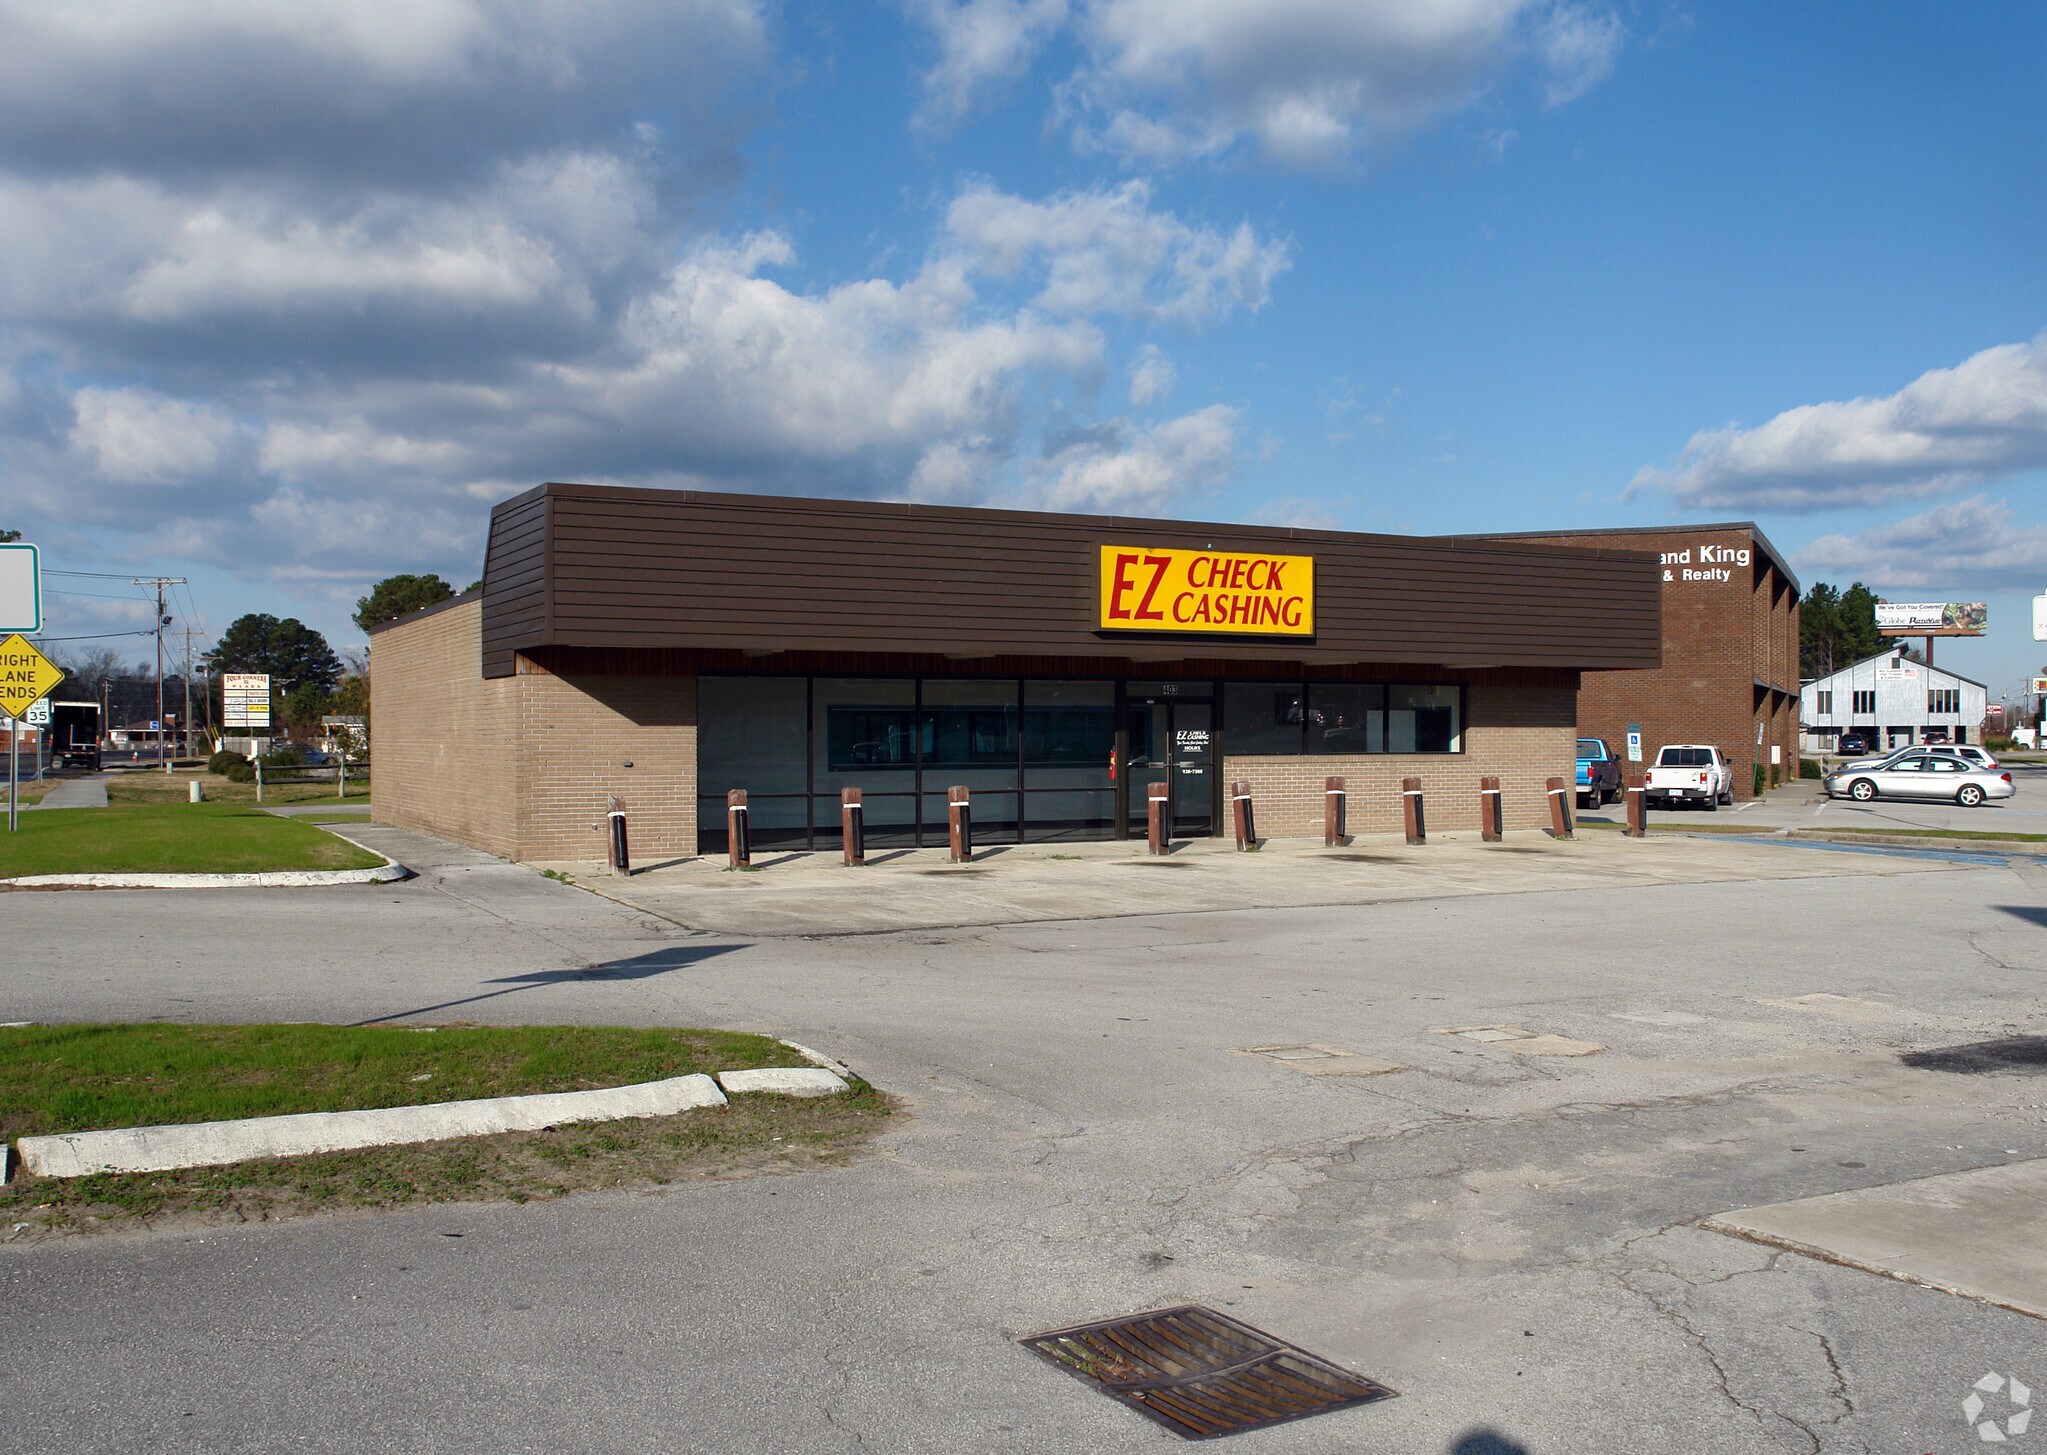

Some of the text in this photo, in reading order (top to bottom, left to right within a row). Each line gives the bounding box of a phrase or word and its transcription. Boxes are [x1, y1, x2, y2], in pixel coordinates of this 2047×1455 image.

[1660, 545, 1750, 567] and King
[1187, 556, 1288, 591] CHECK
[1663, 568, 1731, 582] & Realty
[1109, 553, 1172, 621] EZ
[1172, 591, 1304, 627] CASHING
[0, 654, 38, 667] IGHT
[242, 675, 267, 683] CORNERS
[30, 711, 47, 721] 35
[1176, 730, 1188, 740] EZ
